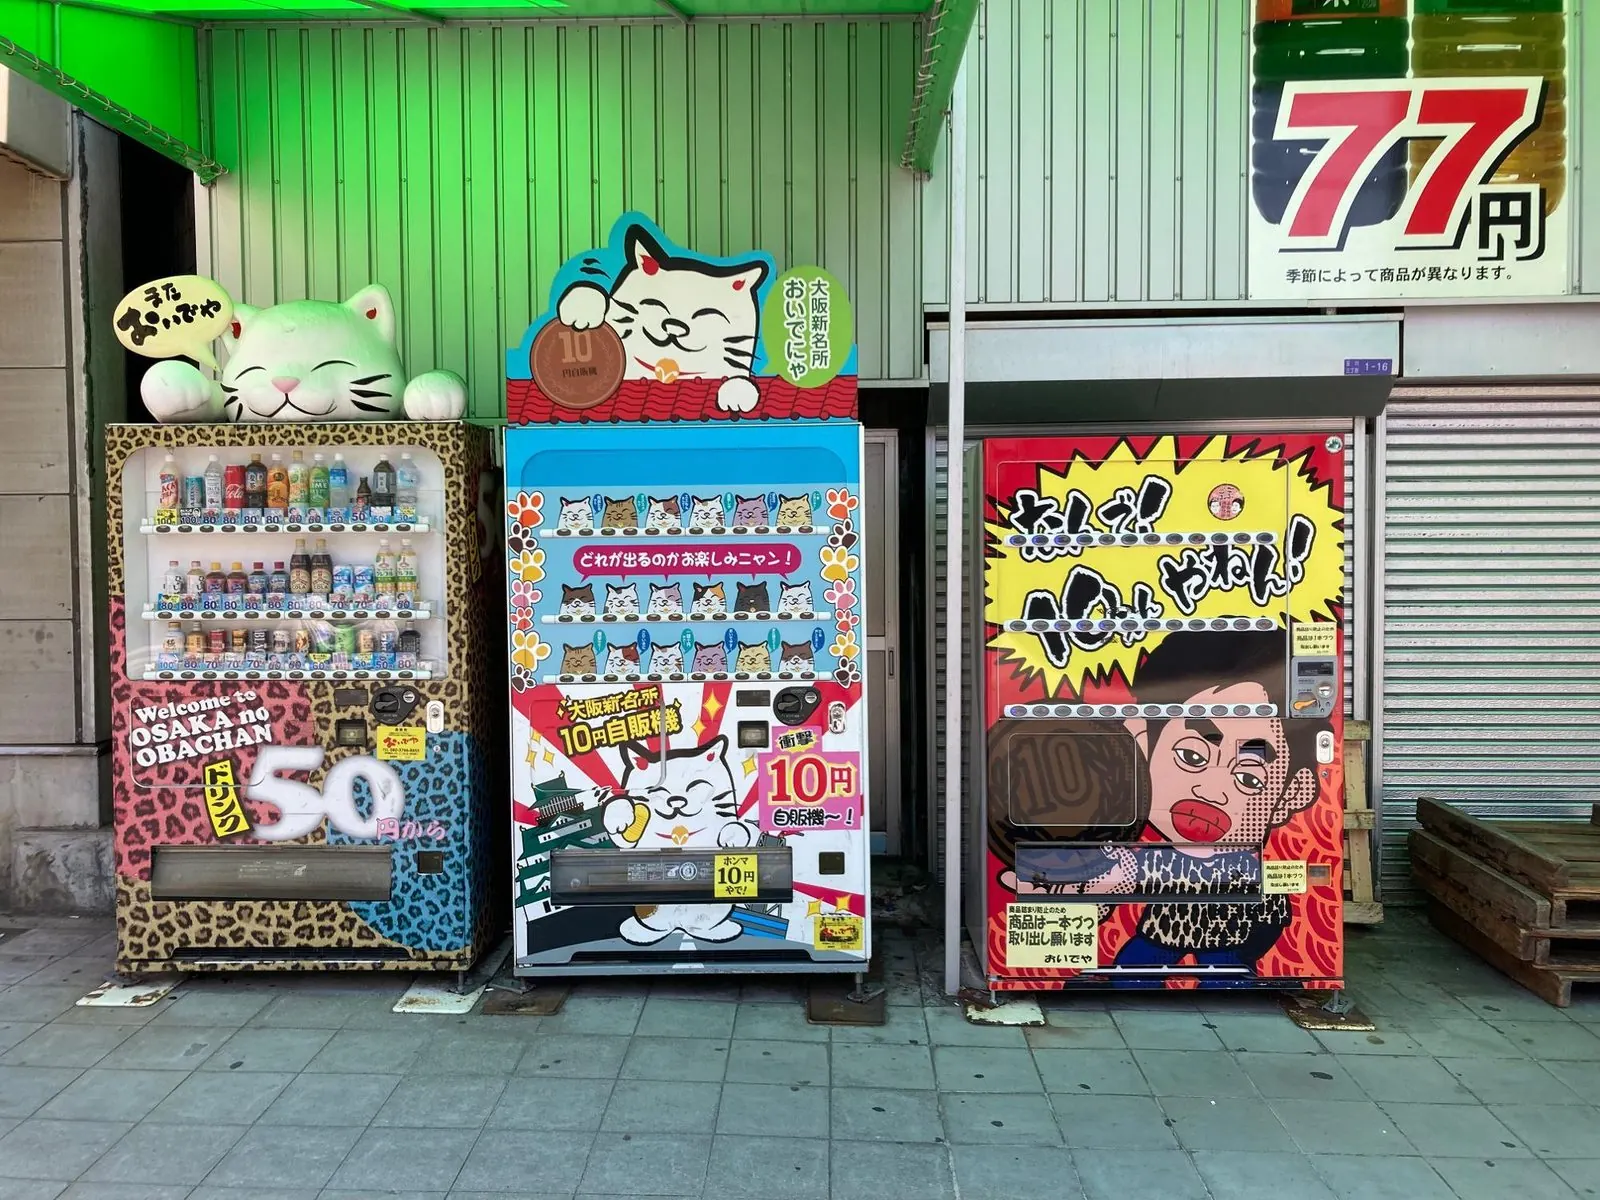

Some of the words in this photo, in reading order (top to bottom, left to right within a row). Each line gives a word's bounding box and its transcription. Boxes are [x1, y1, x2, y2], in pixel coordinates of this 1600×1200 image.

[1274, 79, 1544, 259] 77円
[1285, 266, 1512, 284] 季節によって商品が異なります。
[117, 299, 222, 346] おいでや
[810, 279, 829, 367] 大阪新名所
[558, 330, 593, 363] 10
[1364, 362, 1388, 372] 1-16
[352, 512, 365, 521] 50
[579, 550, 792, 568] どれが出るのかお楽しみニャン！
[204, 601, 217, 609] 80
[224, 601, 237, 609] 80
[287, 601, 300, 610] 80
[135, 696, 231, 723] Welcome
[233, 690, 257, 703] to
[568, 686, 659, 721] 大阪新名所
[132, 710, 234, 746] OSAKA
[238, 706, 270, 725] no
[560, 706, 681, 757] 10円自販機
[136, 724, 273, 767] OBACHAN
[778, 730, 815, 749] 衝撃
[768, 755, 855, 805] 10円
[207, 763, 241, 834] ドリンク
[249, 746, 404, 839] 50
[376, 816, 448, 840] 円から
[723, 857, 749, 866] ホンマ
[717, 867, 755, 885] 10円
[725, 885, 748, 896] やで!
[1009, 915, 1095, 930] 商品は一本づつ
[1009, 931, 1095, 946] 取り出し願います
[1044, 954, 1093, 964] おいでや
